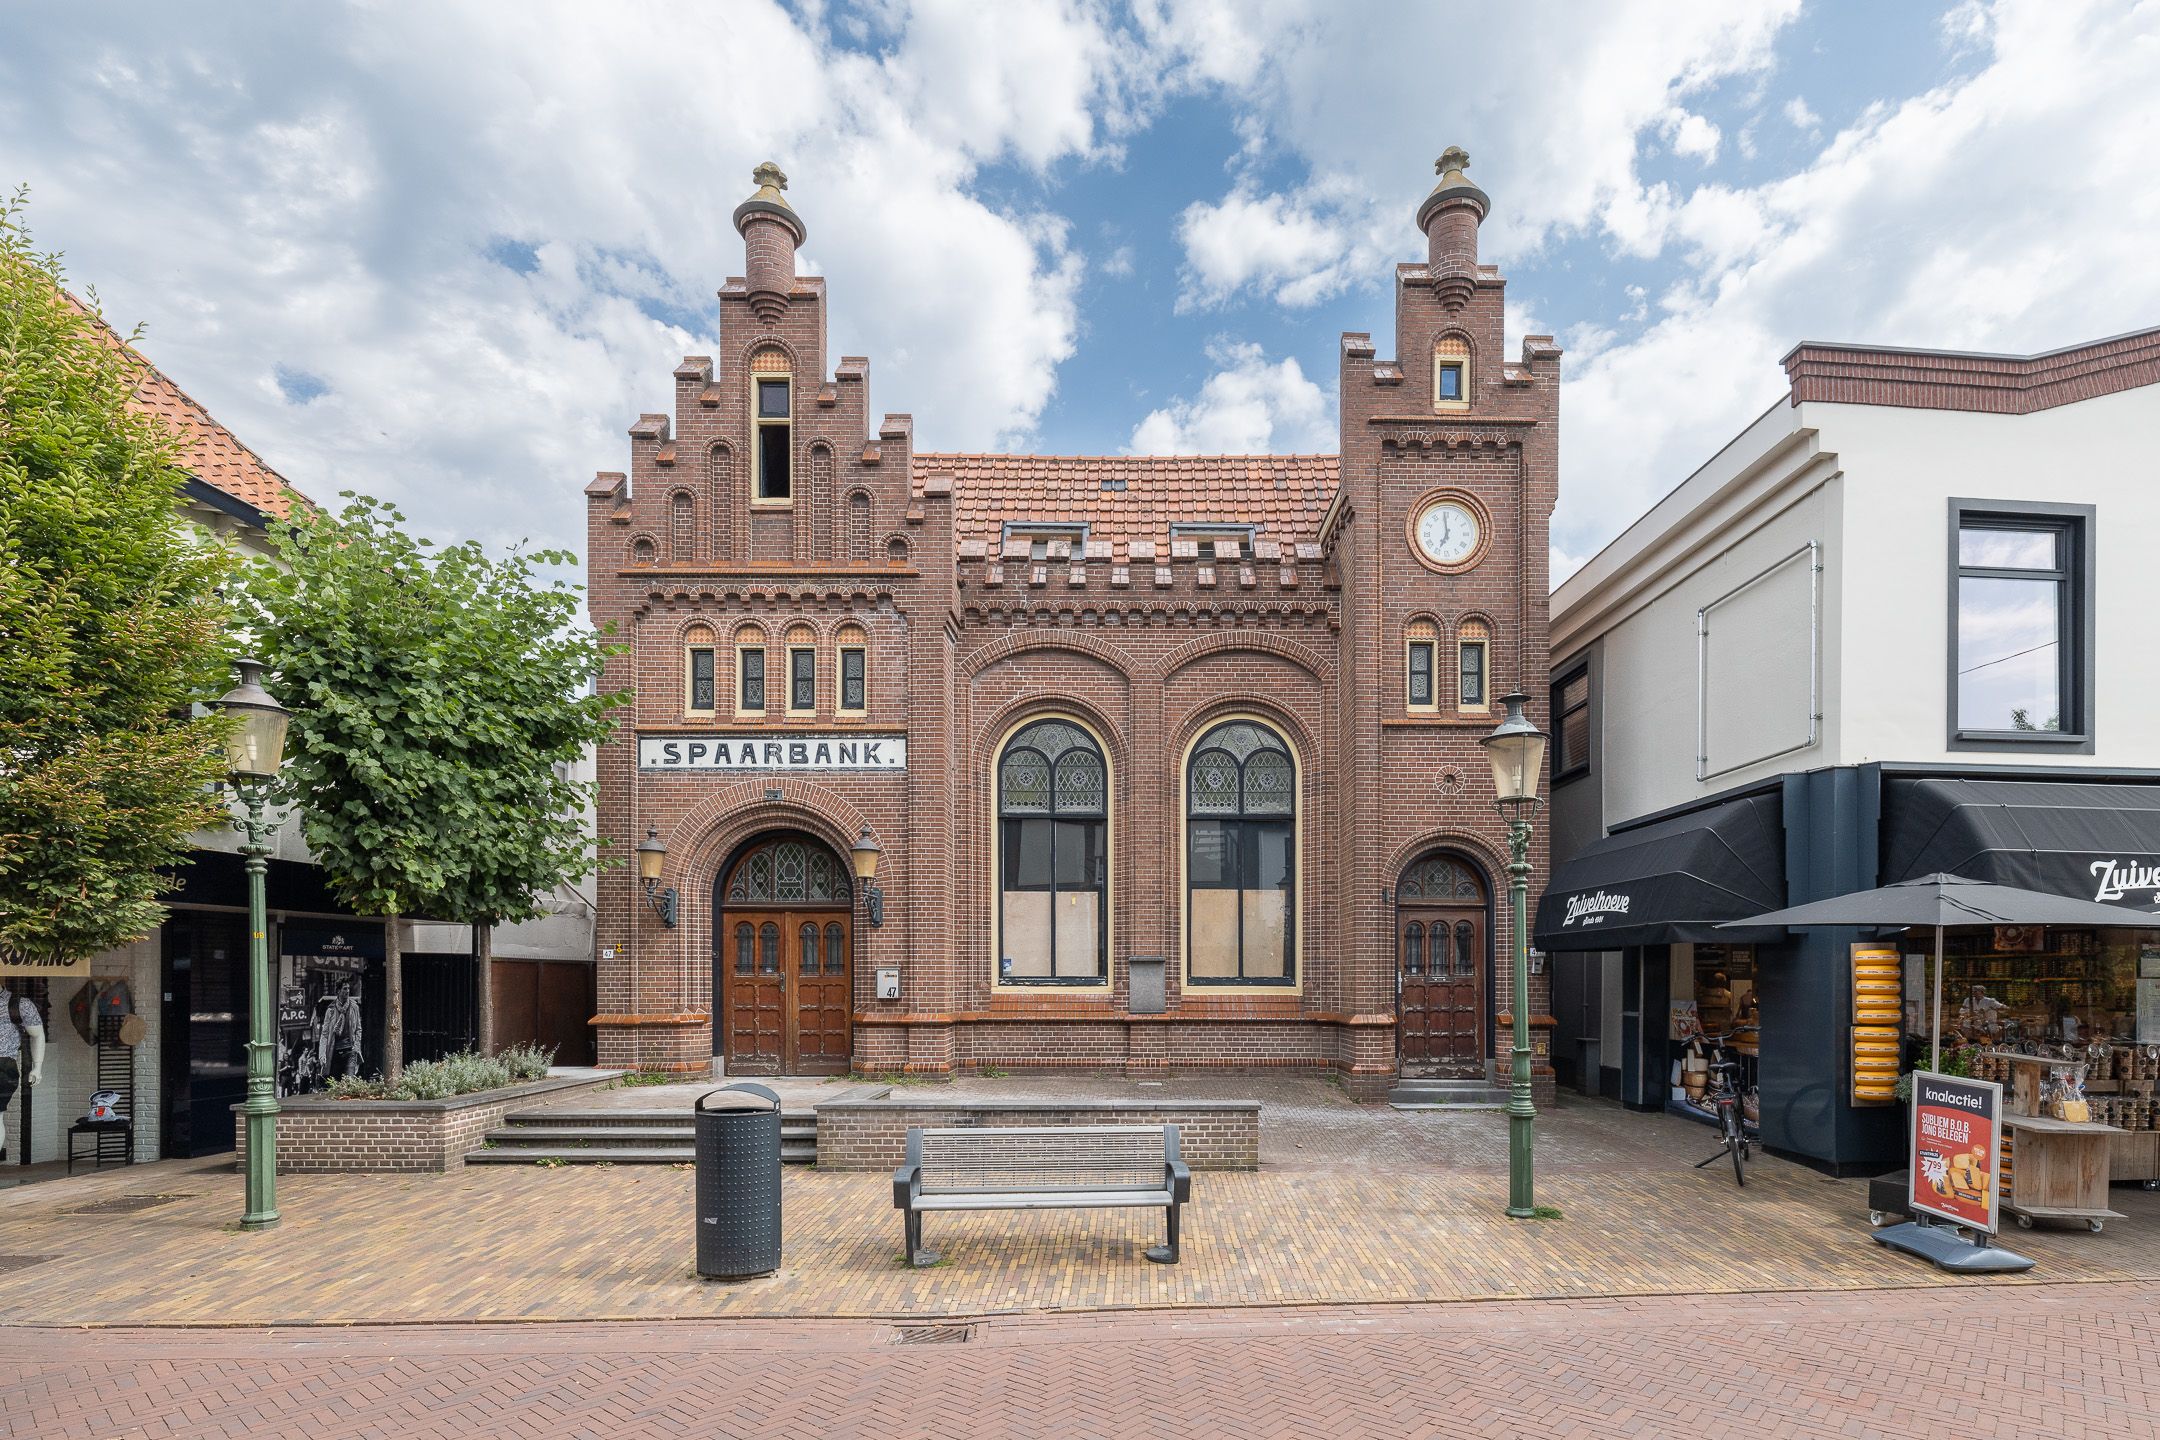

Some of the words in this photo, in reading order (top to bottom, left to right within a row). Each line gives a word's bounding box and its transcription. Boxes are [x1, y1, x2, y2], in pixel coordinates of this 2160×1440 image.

[1563, 891, 1630, 927] Zuivelhoeve
[887, 987, 897, 998] 47
[281, 1010, 307, 1020] A.P.C.
[1925, 1087, 1982, 1109] knalactie!
[1921, 1113, 1949, 1129] SUBLIEM
[1950, 1118, 1971, 1134] B.O.B.
[1921, 1124, 1937, 1136] JONG
[1937, 1127, 1969, 1144] BELEGEN
